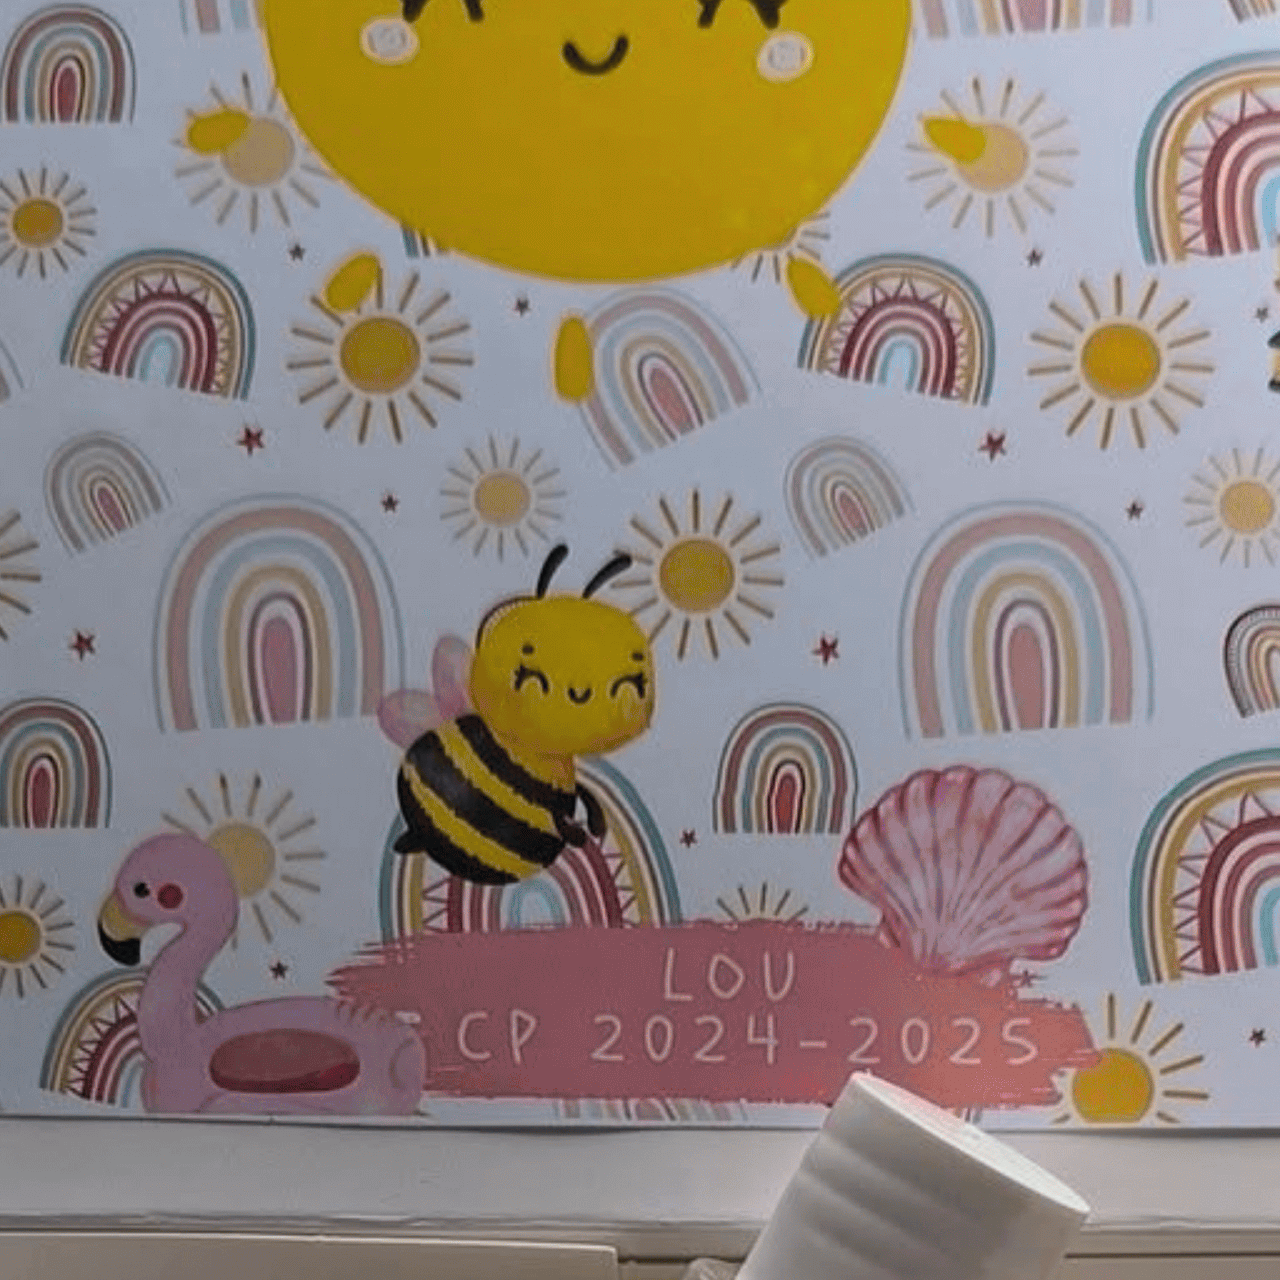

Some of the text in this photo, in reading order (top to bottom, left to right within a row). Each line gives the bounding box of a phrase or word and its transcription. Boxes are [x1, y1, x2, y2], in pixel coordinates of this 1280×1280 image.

[663, 948, 795, 1003] LOU
[457, 1010, 1040, 1067] CP 2024-2025
